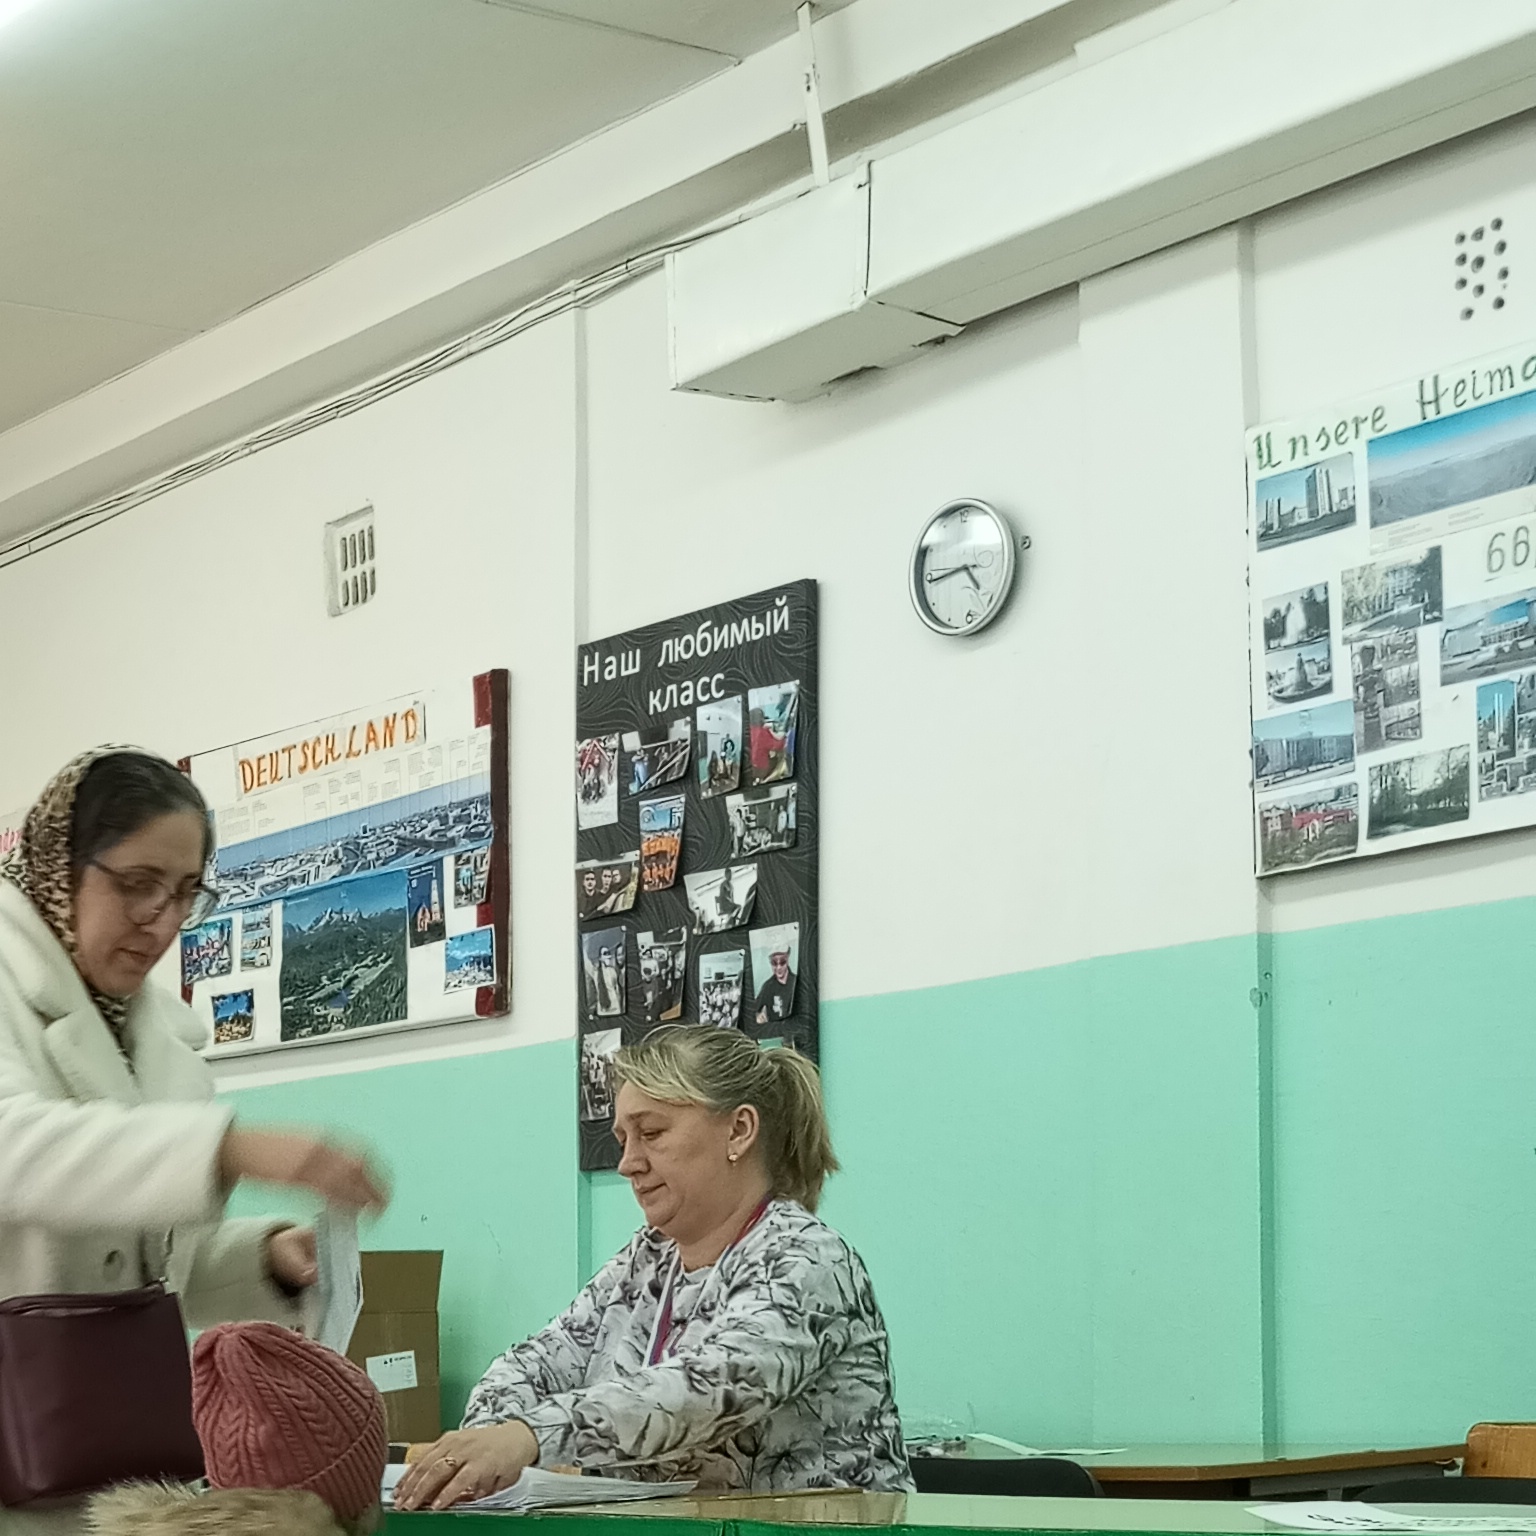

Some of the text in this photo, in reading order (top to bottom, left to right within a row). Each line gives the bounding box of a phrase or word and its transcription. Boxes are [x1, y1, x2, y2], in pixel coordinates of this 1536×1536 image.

[1253, 405, 1388, 470] Unsere
[583, 595, 790, 686] Наш любимый
[649, 673, 725, 715] класс
[238, 707, 420, 794] DEUTSCHLAND
